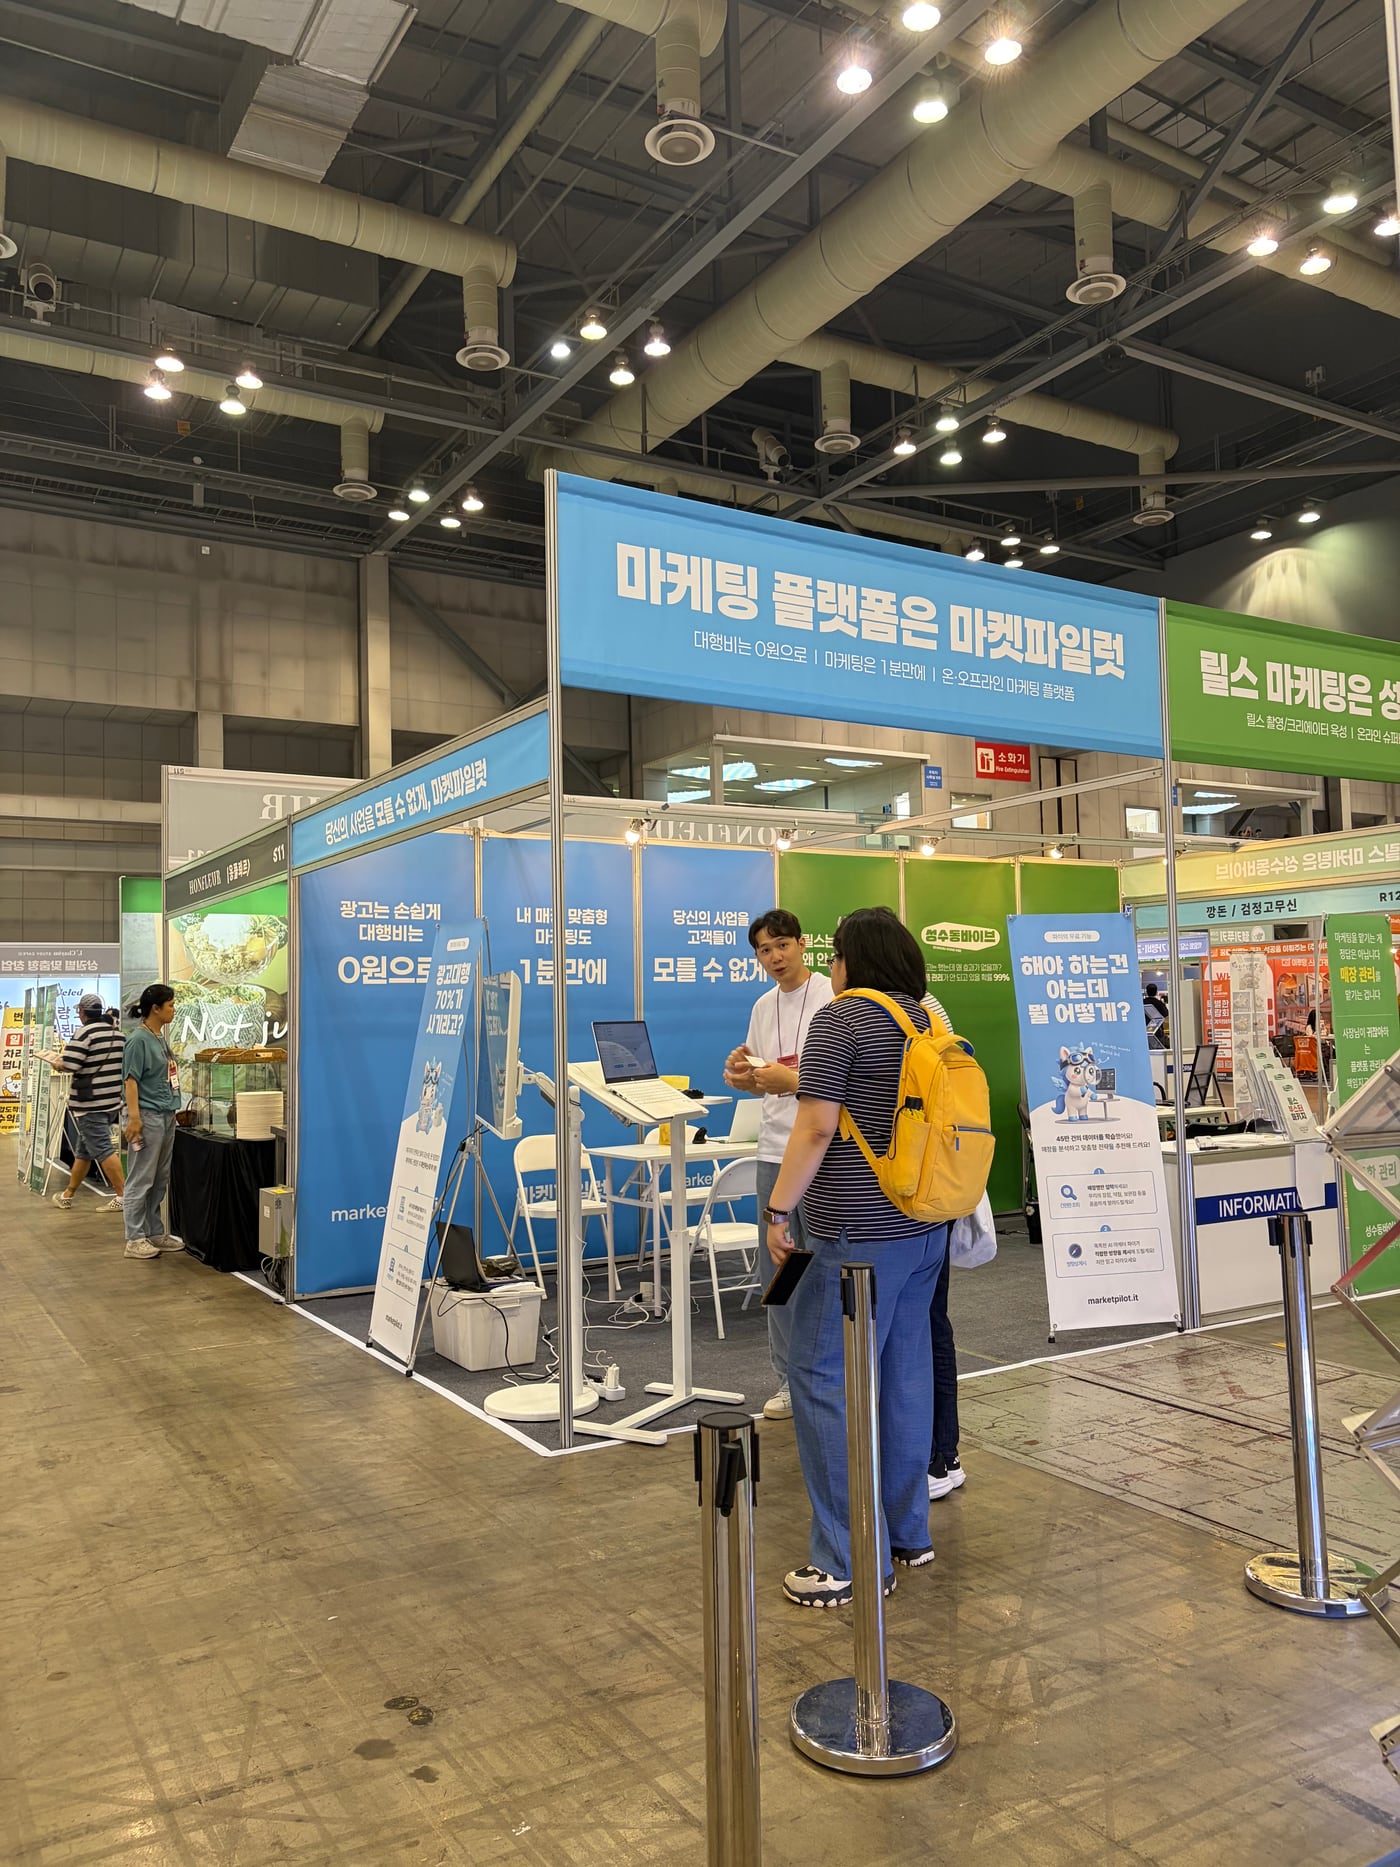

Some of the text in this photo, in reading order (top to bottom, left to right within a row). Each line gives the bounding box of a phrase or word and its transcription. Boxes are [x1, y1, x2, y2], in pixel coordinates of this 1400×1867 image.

[616, 542, 1125, 680] 마케팅 플랫폼은 마켓파일럿
[694, 630, 1075, 702] 대행비는 0원으로 마케팅은 1분만에 온·오프라인 마케팅 플랫폼
[1200, 650, 1259, 699] 릴스
[1266, 661, 1373, 717] 마케팅은
[1246, 712, 1265, 728] 릴스
[1266, 714, 1329, 736] 촬영/크리에이터
[1330, 723, 1347, 739] 육성
[1357, 727, 1381, 743] 온라인
[998, 752, 1025, 765] 소화기
[325, 815, 349, 845] 당신의
[350, 805, 375, 837] 사업을
[375, 796, 395, 827] 모를
[395, 793, 405, 820] 수
[405, 783, 431, 813] 없게,
[430, 758, 487, 806] 마켓파일럿
[273, 844, 285, 863] S11
[188, 870, 221, 895] HONFLEUR
[340, 900, 441, 921] 광고는 손쉽게
[516, 907, 608, 926] 내 매 맞춤형
[672, 909, 749, 927] 당신의 사업을
[1206, 905, 1227, 919] 깡돈
[1241, 898, 1297, 916] 검정고무신
[359, 924, 424, 942] 대행비는
[535, 929, 592, 945] 마팅도
[687, 929, 736, 946] 고객들이
[925, 929, 996, 942] 성수동바이브
[1334, 932, 1357, 943] 마케팅을
[1358, 932, 1376, 943] 맡기는
[802, 952, 814, 966] 왜
[1339, 948, 1380, 960] 정답은 아닙니다
[436, 962, 472, 986] 광고대행
[653, 957, 768, 984] 모를 수 없게
[1020, 954, 1129, 975] 해야 하는건
[1340, 966, 1357, 983] 매장
[1046, 979, 1109, 999] 아는데
[1345, 989, 1380, 1000] 맡기는 겁니다
[434, 988, 464, 1010] 70%가
[1028, 1002, 1131, 1025] 뭘 어떻게?
[181, 1012, 254, 1043] Not
[426, 1014, 464, 1036] 사기라고?
[1343, 1027, 1365, 1039] 사장님이
[1364, 1044, 1371, 1054] 는
[1350, 1060, 1368, 1072] 플랫폼
[1379, 1161, 1397, 1180] 관리
[1087, 1294, 1139, 1305] marketpilot.it
